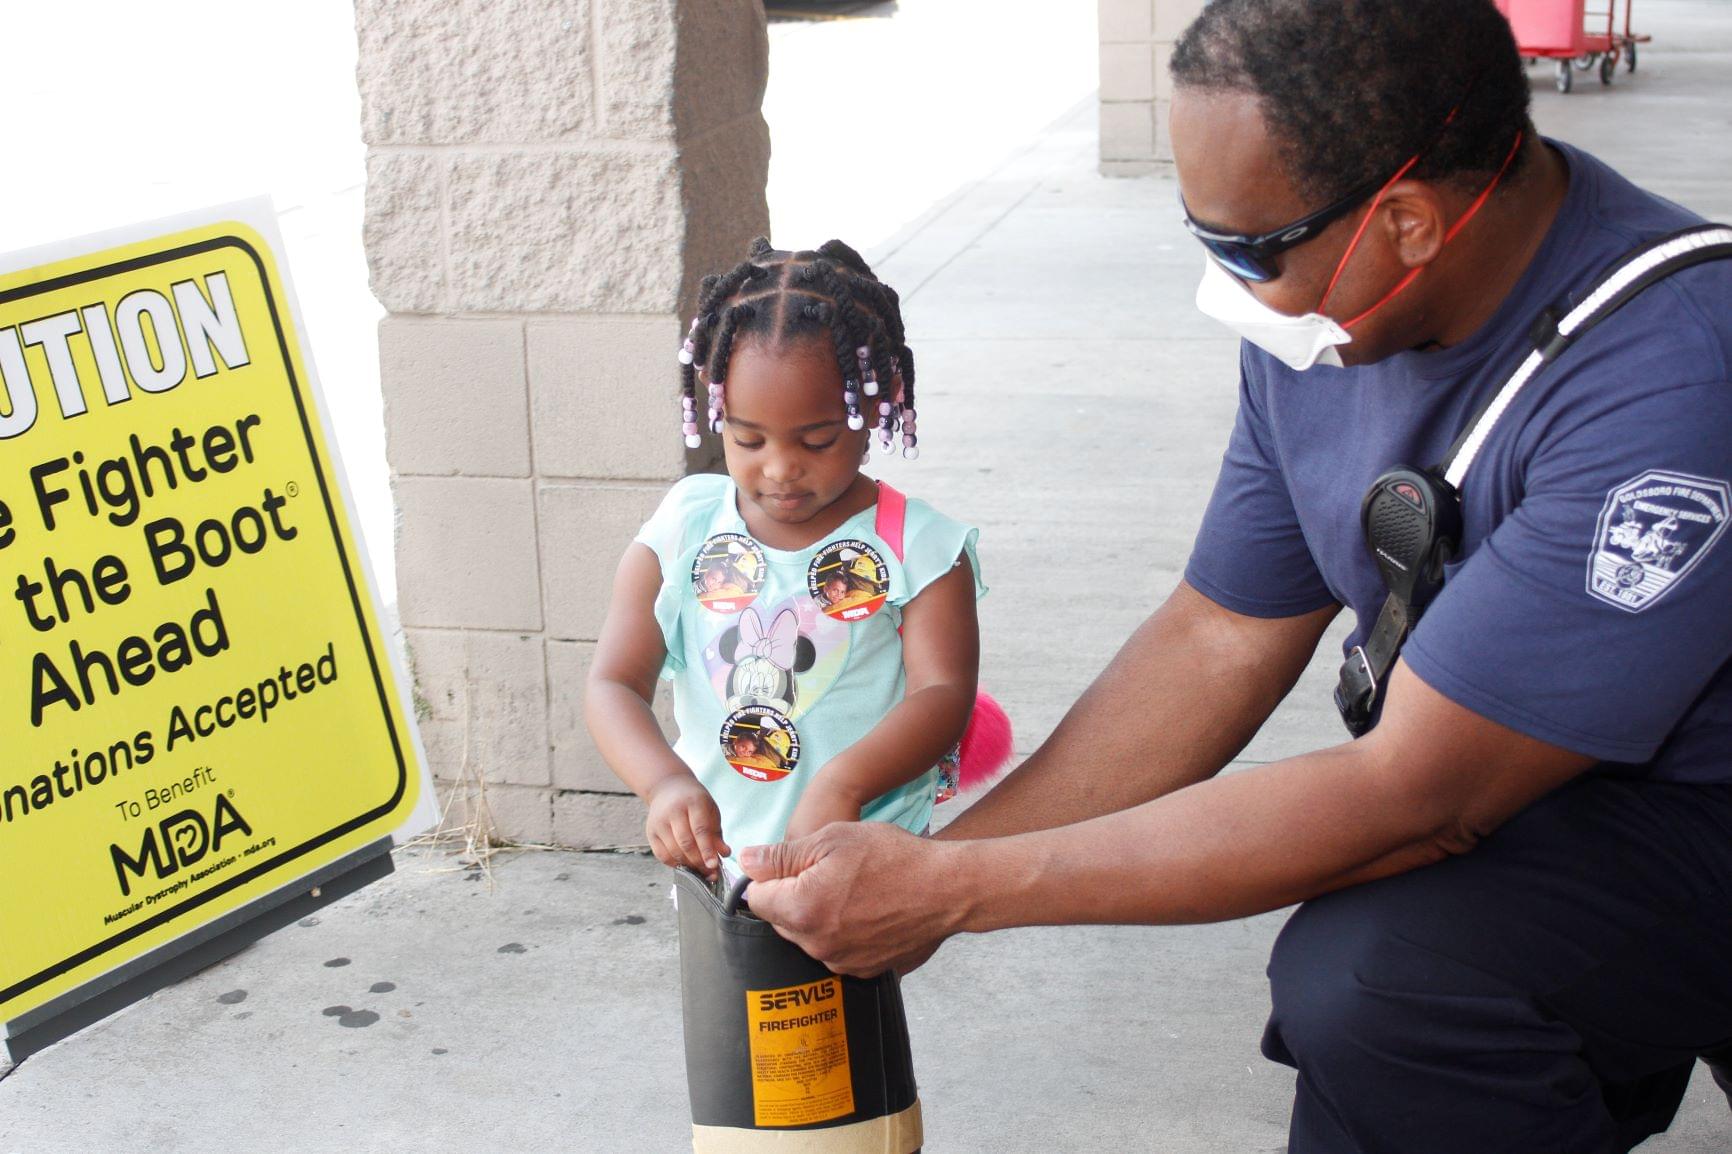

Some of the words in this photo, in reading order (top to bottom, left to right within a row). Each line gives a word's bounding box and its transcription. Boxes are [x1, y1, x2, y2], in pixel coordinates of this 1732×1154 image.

[30, 414, 260, 527] Fighter
[1673, 487, 1692, 499] FIRE
[851, 542, 865, 550] HELP
[15, 557, 131, 632] the
[31, 588, 230, 728] Ahead
[0, 731, 154, 823] nations
[167, 642, 338, 752] Accepted
[116, 801, 141, 822] To
[144, 766, 216, 811] Benefit
[104, 900, 144, 926] Muscular
[145, 879, 188, 905] Dystrophy
[190, 855, 236, 883] Association
[244, 837, 276, 858] mda.org
[759, 1009, 838, 1032] FIREFIGHTER
[760, 981, 835, 1012] SERVUS
